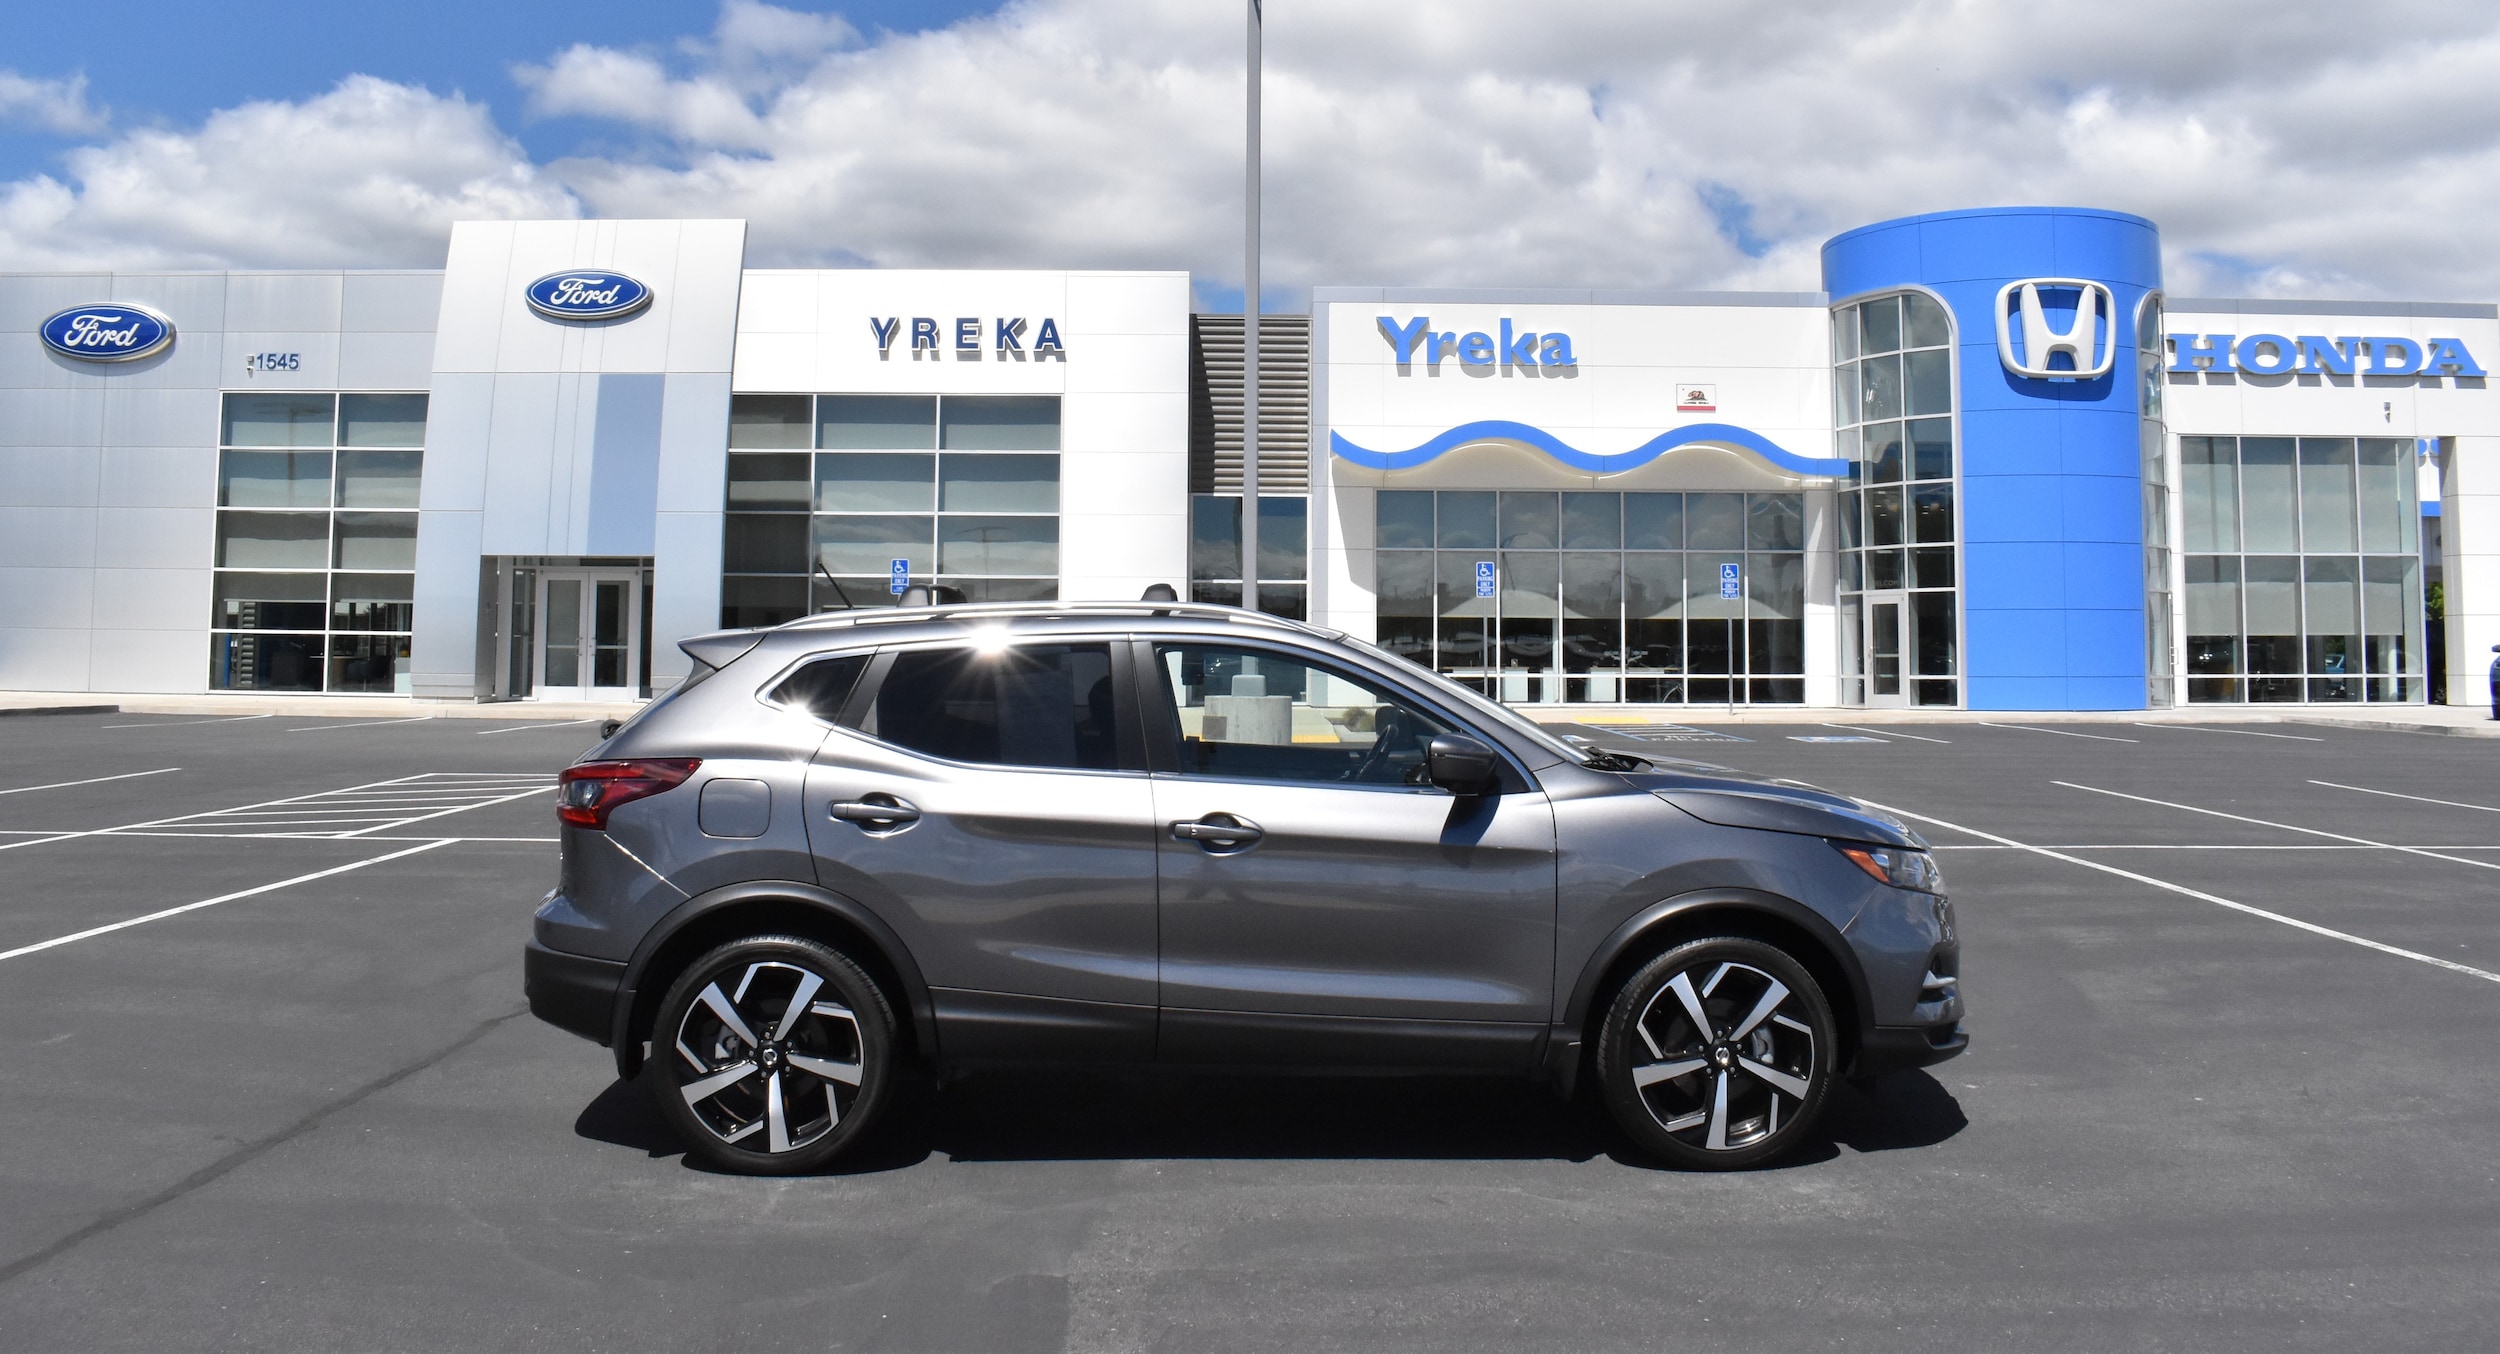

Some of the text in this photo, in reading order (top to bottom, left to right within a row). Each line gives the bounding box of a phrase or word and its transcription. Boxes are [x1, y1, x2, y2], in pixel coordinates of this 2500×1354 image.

[550, 278, 621, 305] Ford
[63, 314, 140, 347] Ford
[869, 316, 1066, 352] YREKA
[1376, 316, 1578, 366] Yreka
[256, 353, 299, 370] 1545
[2167, 333, 2488, 377] HONDA
